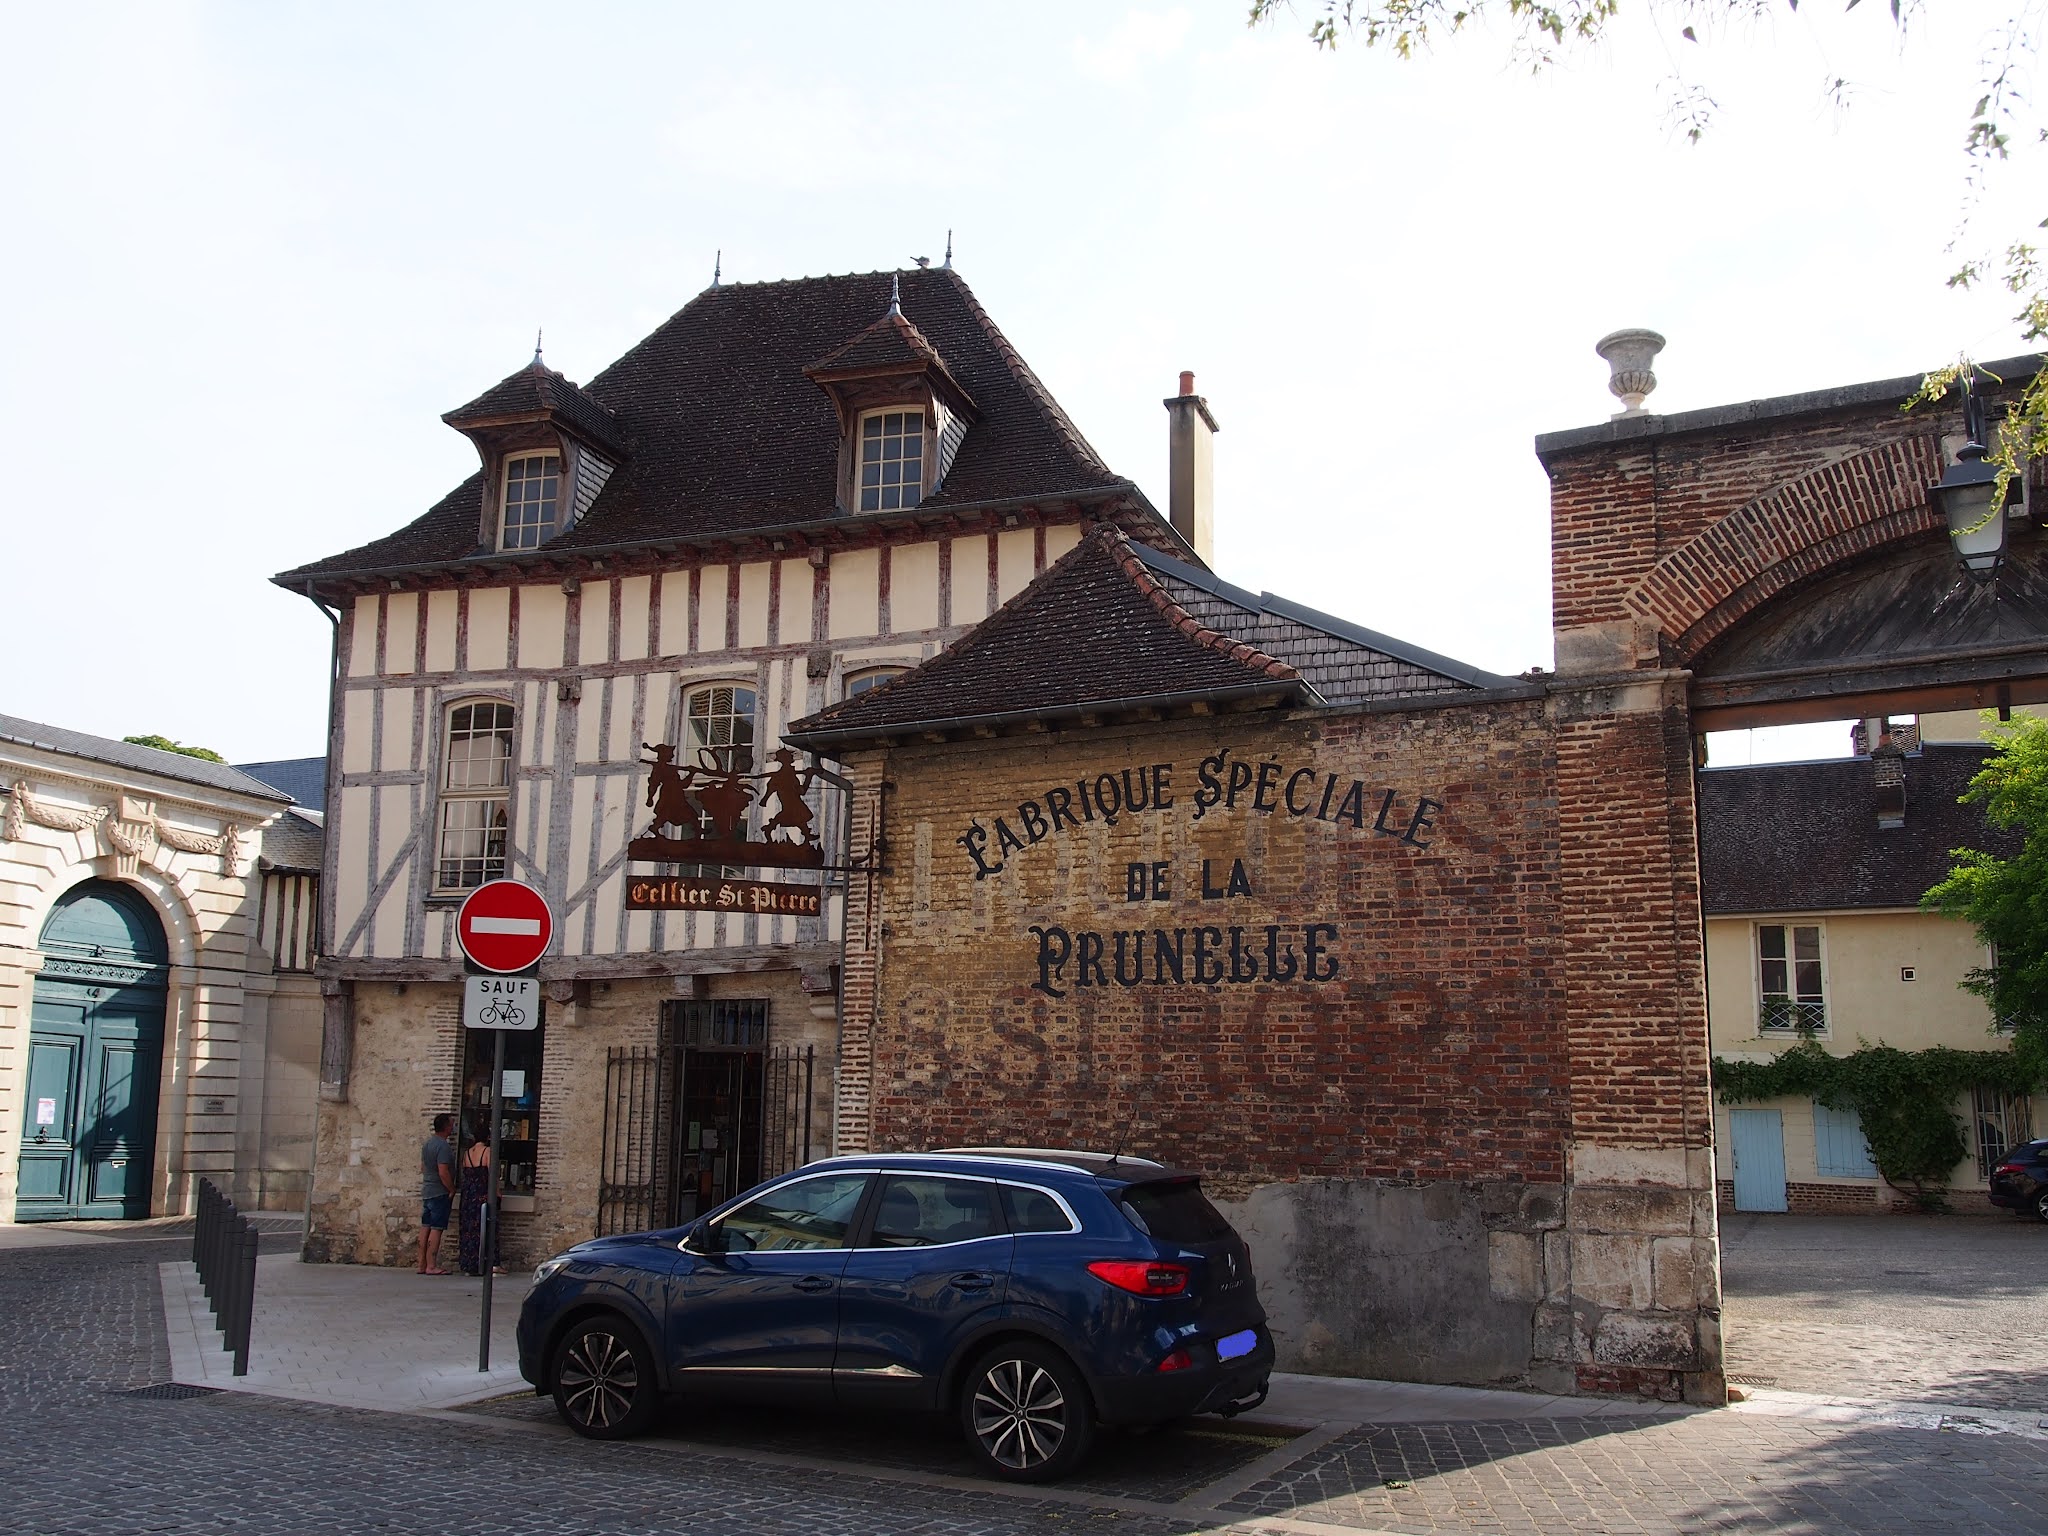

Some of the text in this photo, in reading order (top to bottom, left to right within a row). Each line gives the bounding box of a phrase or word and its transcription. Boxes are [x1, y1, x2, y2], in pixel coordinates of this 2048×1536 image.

[956, 762, 1175, 880] FABRIQUE
[1192, 747, 1445, 850] SPÉCIALE
[631, 881, 818, 912] Cellier St Pierre
[1127, 858, 1253, 903] DE LA
[1028, 923, 1340, 998] PRUNELLE
[480, 980, 529, 995] SAUF
